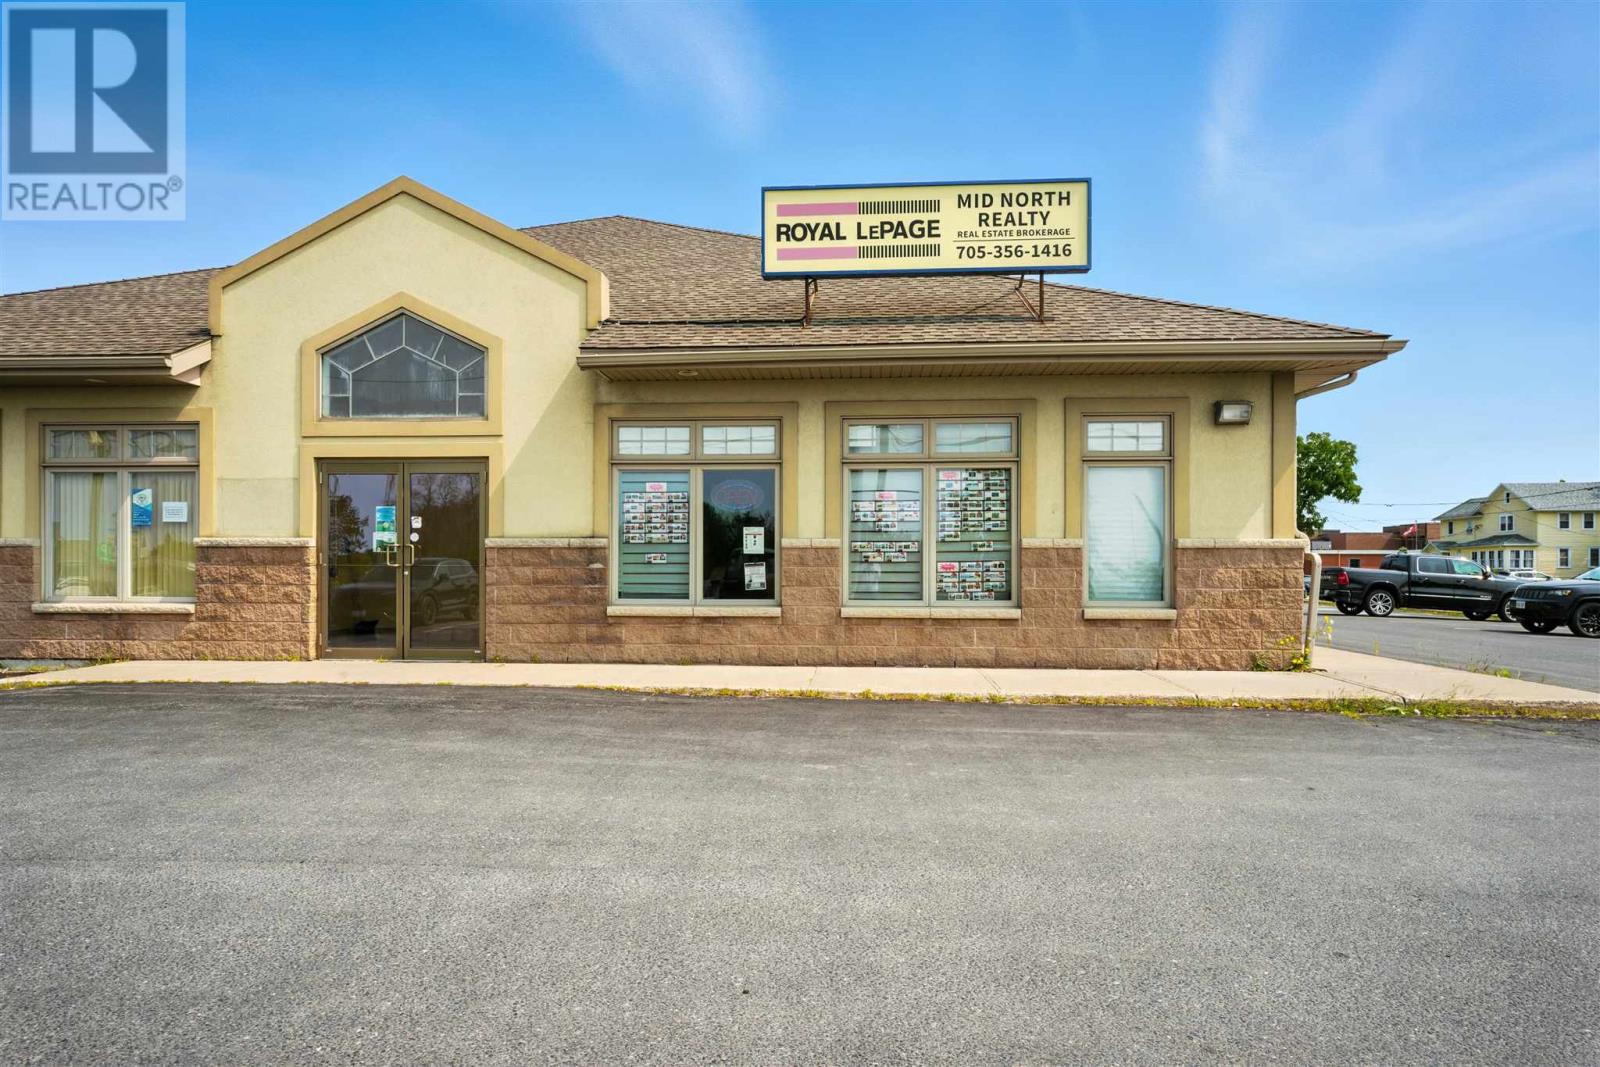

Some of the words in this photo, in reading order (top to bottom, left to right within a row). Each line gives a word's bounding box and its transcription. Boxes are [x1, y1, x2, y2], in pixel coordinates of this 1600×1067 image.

[957, 193, 994, 208] MID
[1000, 191, 1071, 207] NORTH
[978, 211, 1050, 227] REALTY
[776, 222, 847, 242] ROYAL
[957, 230, 979, 238] REAL
[981, 229, 1014, 238] ESTATE
[1016, 228, 1071, 237] BROKERAGE
[956, 243, 1072, 259] 705-356-1416
